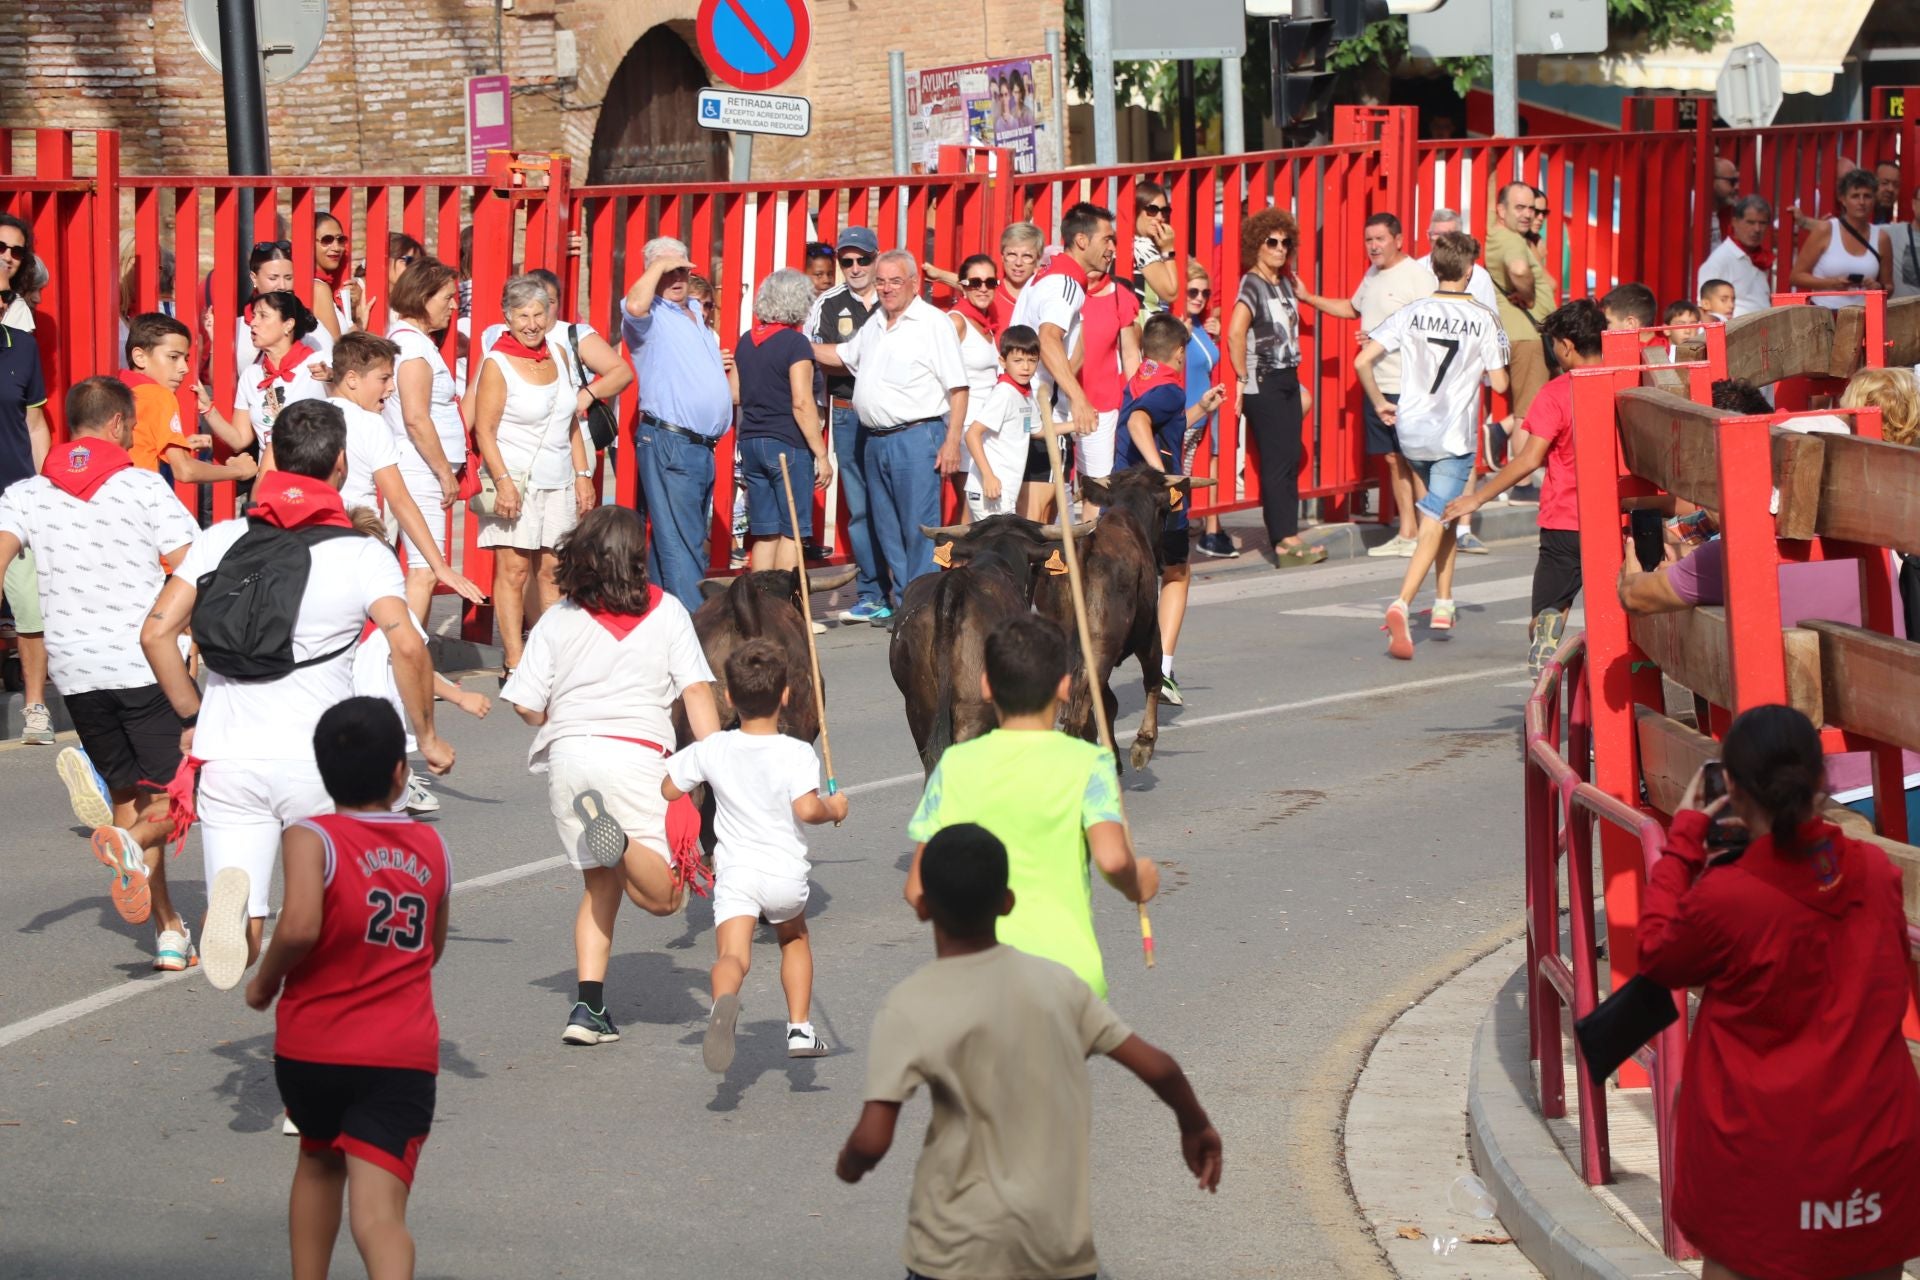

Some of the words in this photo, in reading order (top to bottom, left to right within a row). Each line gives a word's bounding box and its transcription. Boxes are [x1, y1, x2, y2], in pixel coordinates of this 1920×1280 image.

[724, 107, 755, 117] EXCEPTO
[756, 110, 803, 121] ACREDITADOS
[727, 97, 773, 109] RETIRADA
[722, 116, 732, 124] DE
[733, 118, 769, 128] MOVILIDAD
[770, 121, 804, 130] REDUCIDA
[1409, 314, 1482, 337] ALMAZAN
[1426, 337, 1460, 395] 7
[357, 847, 432, 887] JORDAN
[365, 886, 427, 952] 23
[1800, 1187, 1882, 1230] INÉS
